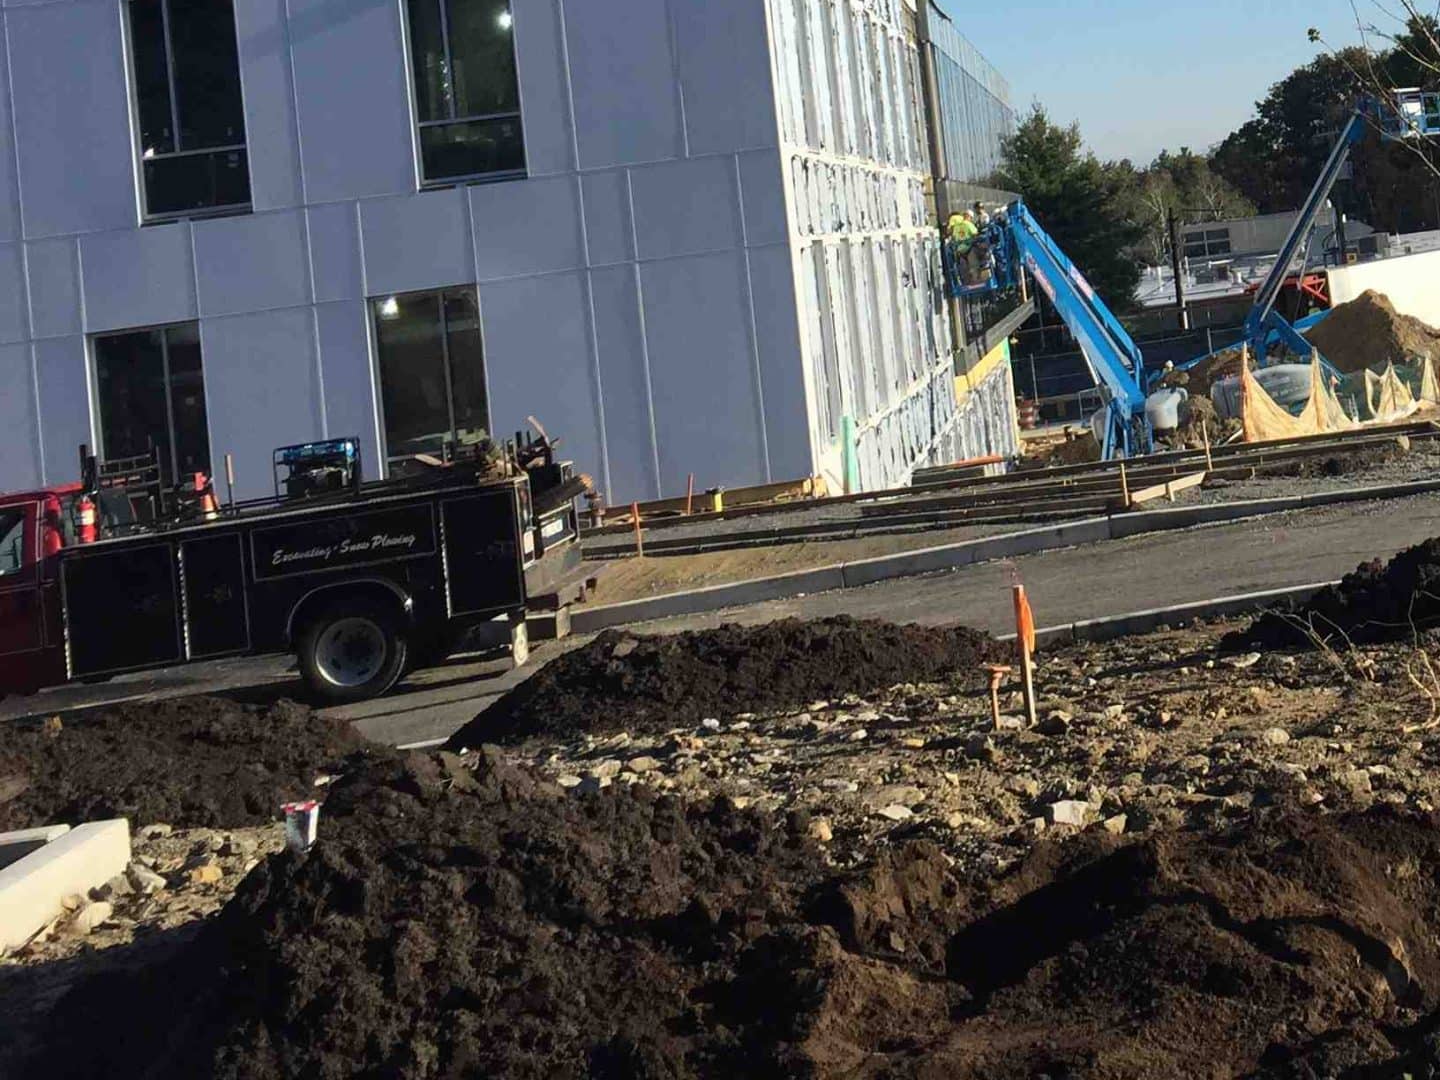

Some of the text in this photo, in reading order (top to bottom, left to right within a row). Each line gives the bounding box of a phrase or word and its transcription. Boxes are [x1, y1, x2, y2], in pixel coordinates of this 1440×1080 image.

[272, 534, 416, 565] Excavating Snow Plowing
